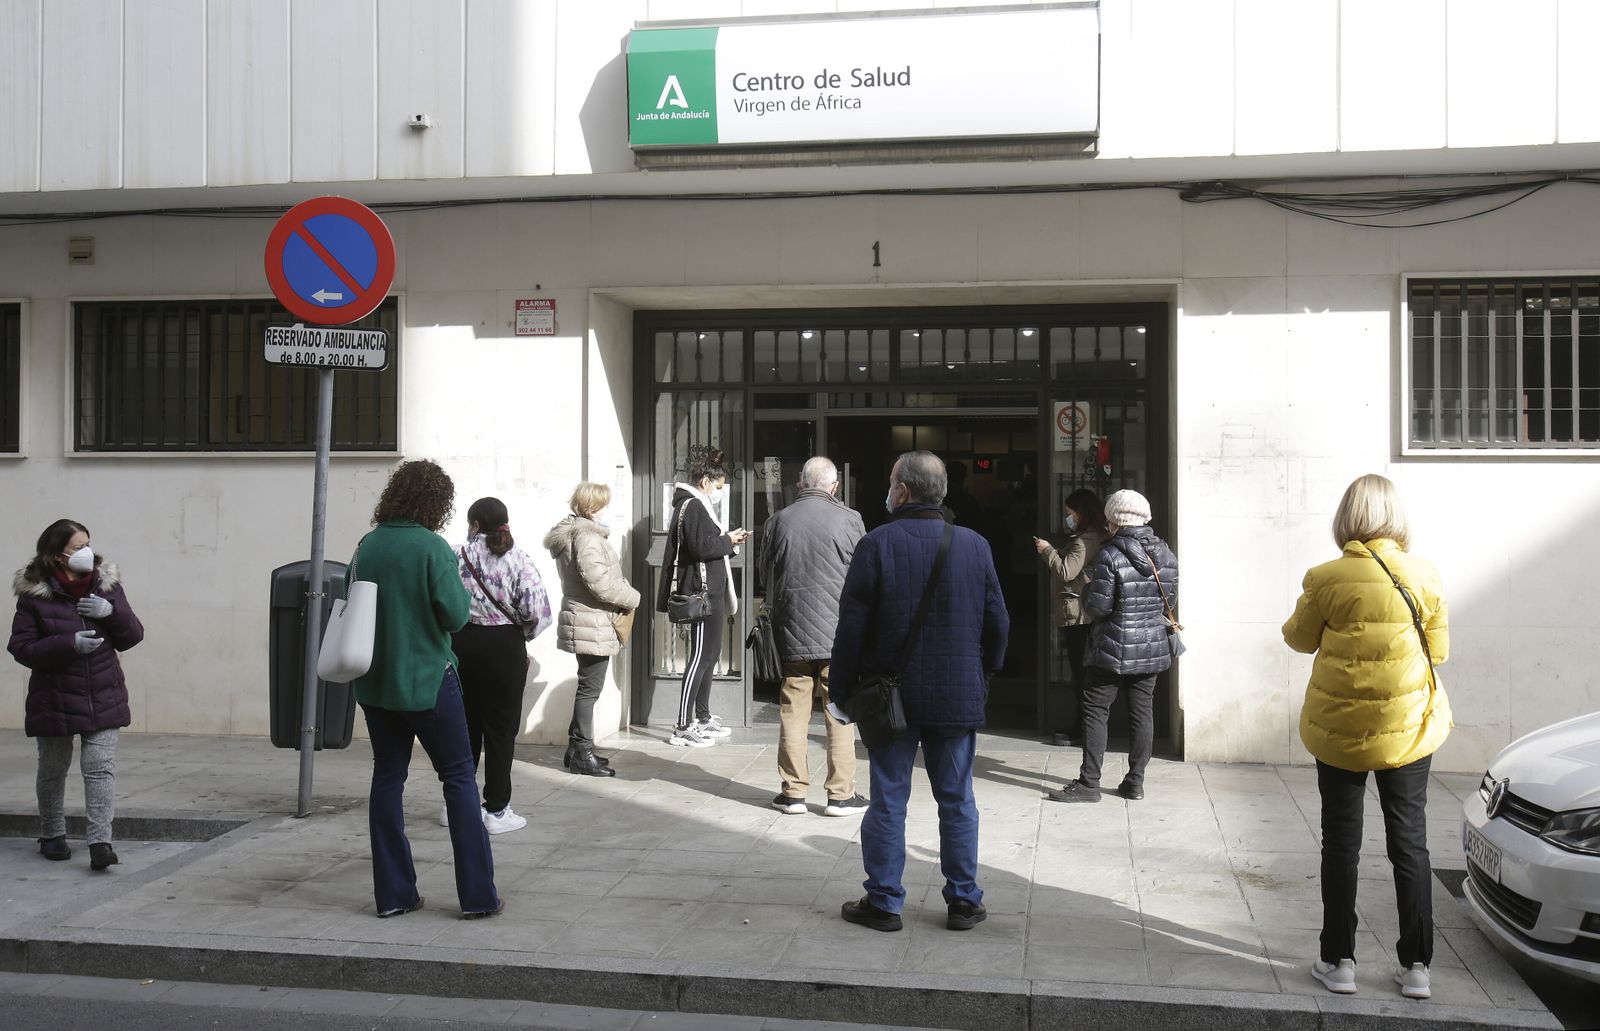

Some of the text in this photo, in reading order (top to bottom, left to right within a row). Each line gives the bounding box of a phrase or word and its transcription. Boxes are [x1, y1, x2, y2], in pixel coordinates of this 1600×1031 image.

[732, 65, 912, 93] Centro de Salud
[636, 109, 710, 121] Junta de Andalucía
[733, 93, 862, 117] Virgen de África
[872, 240, 881, 267] 1
[265, 328, 386, 351] RESERVADO AMBULANCIA
[280, 351, 368, 367] de 8.00 a 20.00 H.
[977, 460, 990, 469] 48
[1468, 830, 1499, 875] 8352HRP
